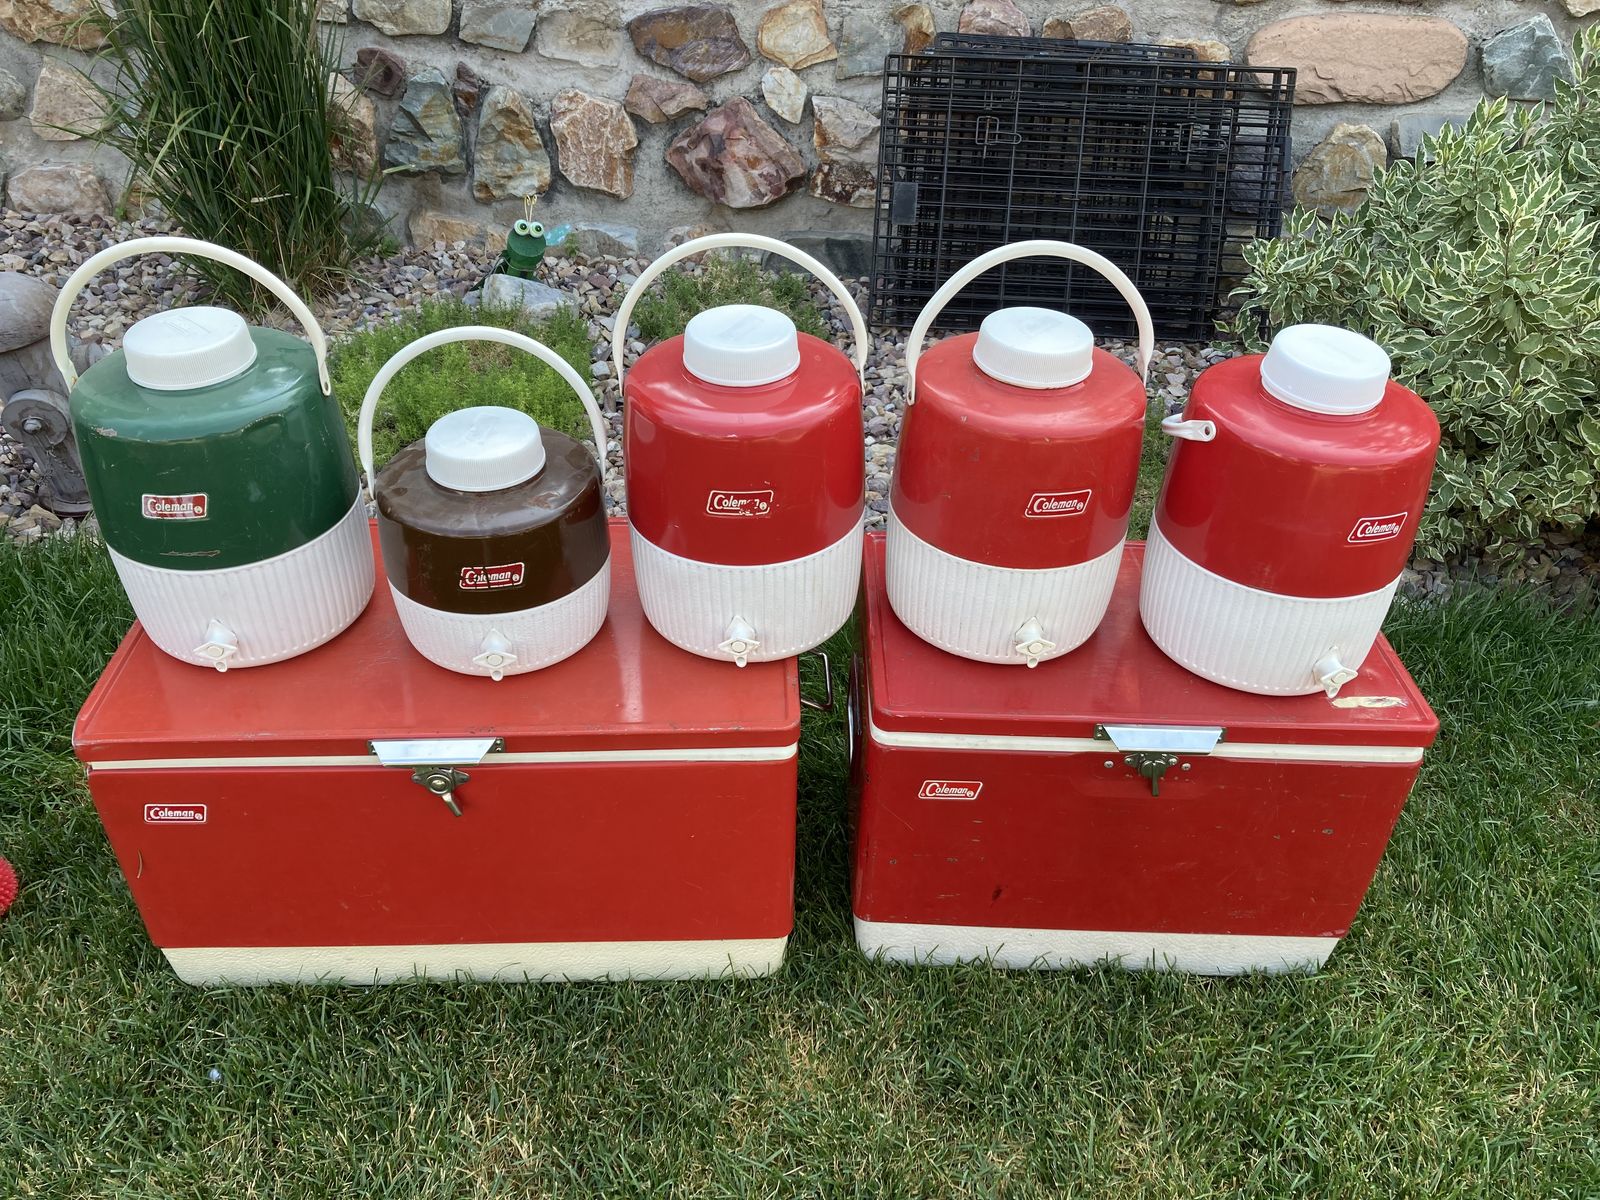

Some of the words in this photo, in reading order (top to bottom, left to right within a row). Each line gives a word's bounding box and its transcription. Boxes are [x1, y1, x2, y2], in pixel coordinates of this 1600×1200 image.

[148, 499, 193, 513] Coleman
[1033, 498, 1078, 512] Coleman
[1357, 522, 1396, 537] Coleman
[926, 783, 968, 796] Coleman
[150, 807, 194, 819] Coleman
